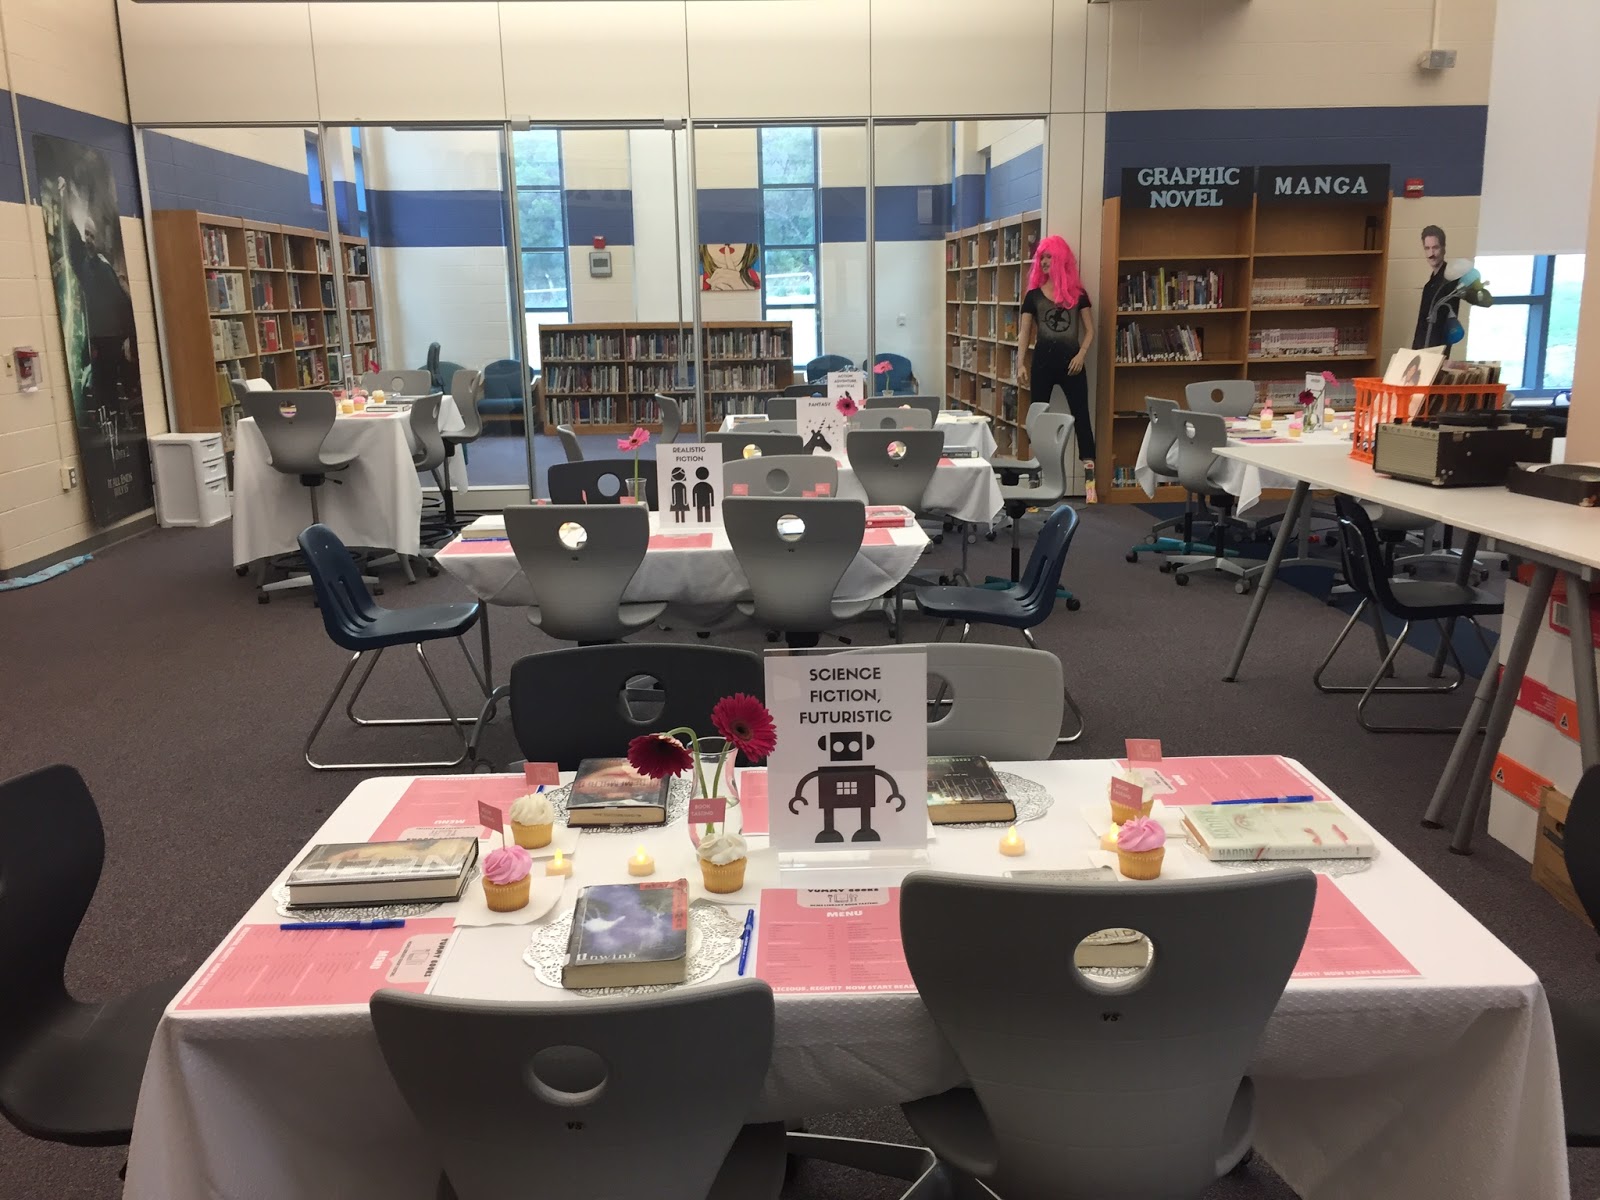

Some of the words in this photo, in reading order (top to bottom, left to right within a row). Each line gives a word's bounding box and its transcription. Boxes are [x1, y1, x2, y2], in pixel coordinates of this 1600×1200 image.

[1137, 166, 1240, 186] GRAPHIC
[1274, 176, 1369, 195] MANGA
[1149, 188, 1223, 209] NOVEL
[809, 667, 882, 681] SCIENCE
[810, 688, 882, 704] FICTION,
[799, 709, 893, 725] FUTURISTIC
[826, 910, 863, 918] MENU
[1102, 1013, 1121, 1022] VS
